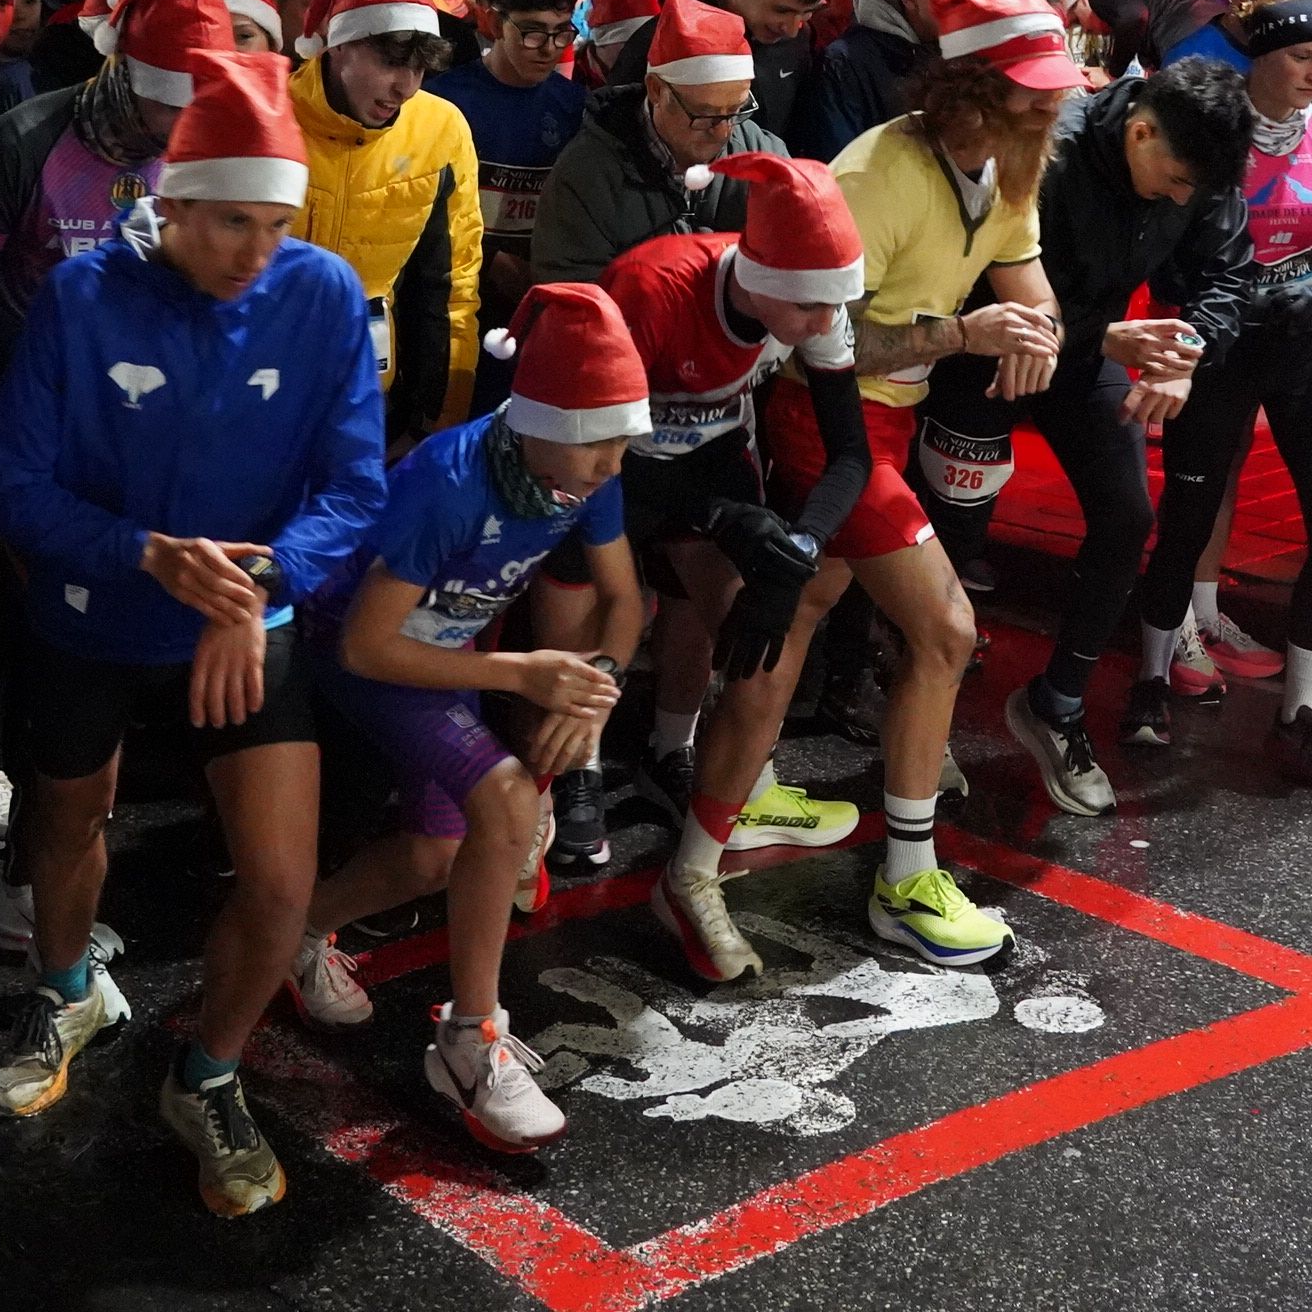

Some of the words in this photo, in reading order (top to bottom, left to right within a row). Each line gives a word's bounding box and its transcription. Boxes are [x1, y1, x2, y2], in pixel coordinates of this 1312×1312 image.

[506, 199, 537, 219] 216
[48, 217, 96, 231] CLUB
[944, 464, 984, 490] 326
[1175, 472, 1206, 483] NIKE
